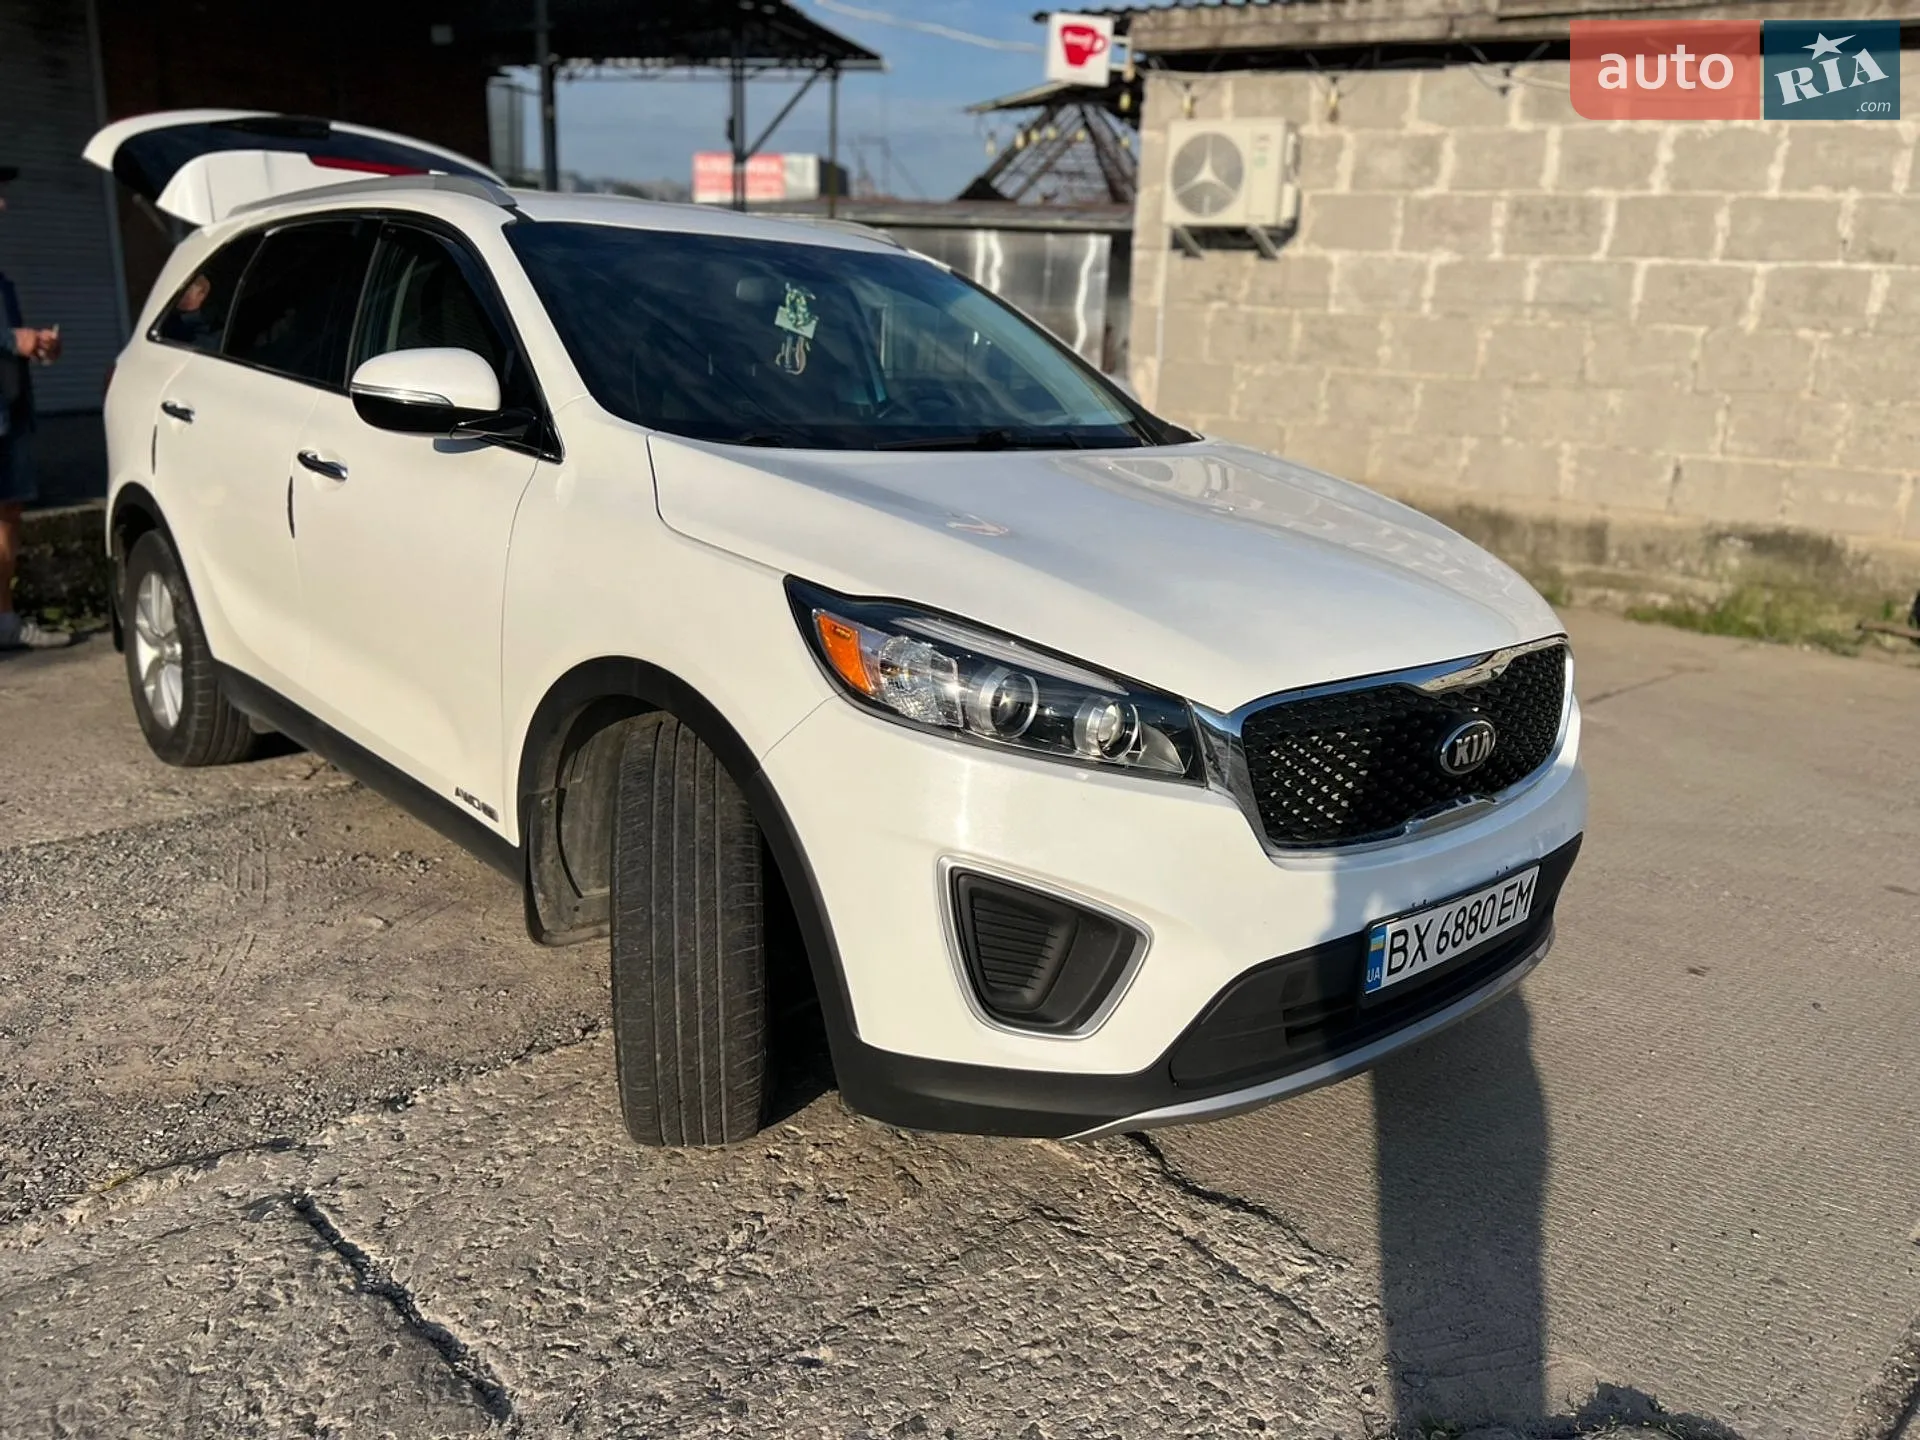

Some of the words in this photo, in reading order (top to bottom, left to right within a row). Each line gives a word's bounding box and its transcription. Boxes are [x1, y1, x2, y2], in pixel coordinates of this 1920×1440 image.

[1453, 730, 1490, 767] KIA
[1386, 918, 1434, 977] BX
[1436, 893, 1497, 955] 6880
[1496, 874, 1536, 928] EM
[1367, 967, 1382, 983] UA
